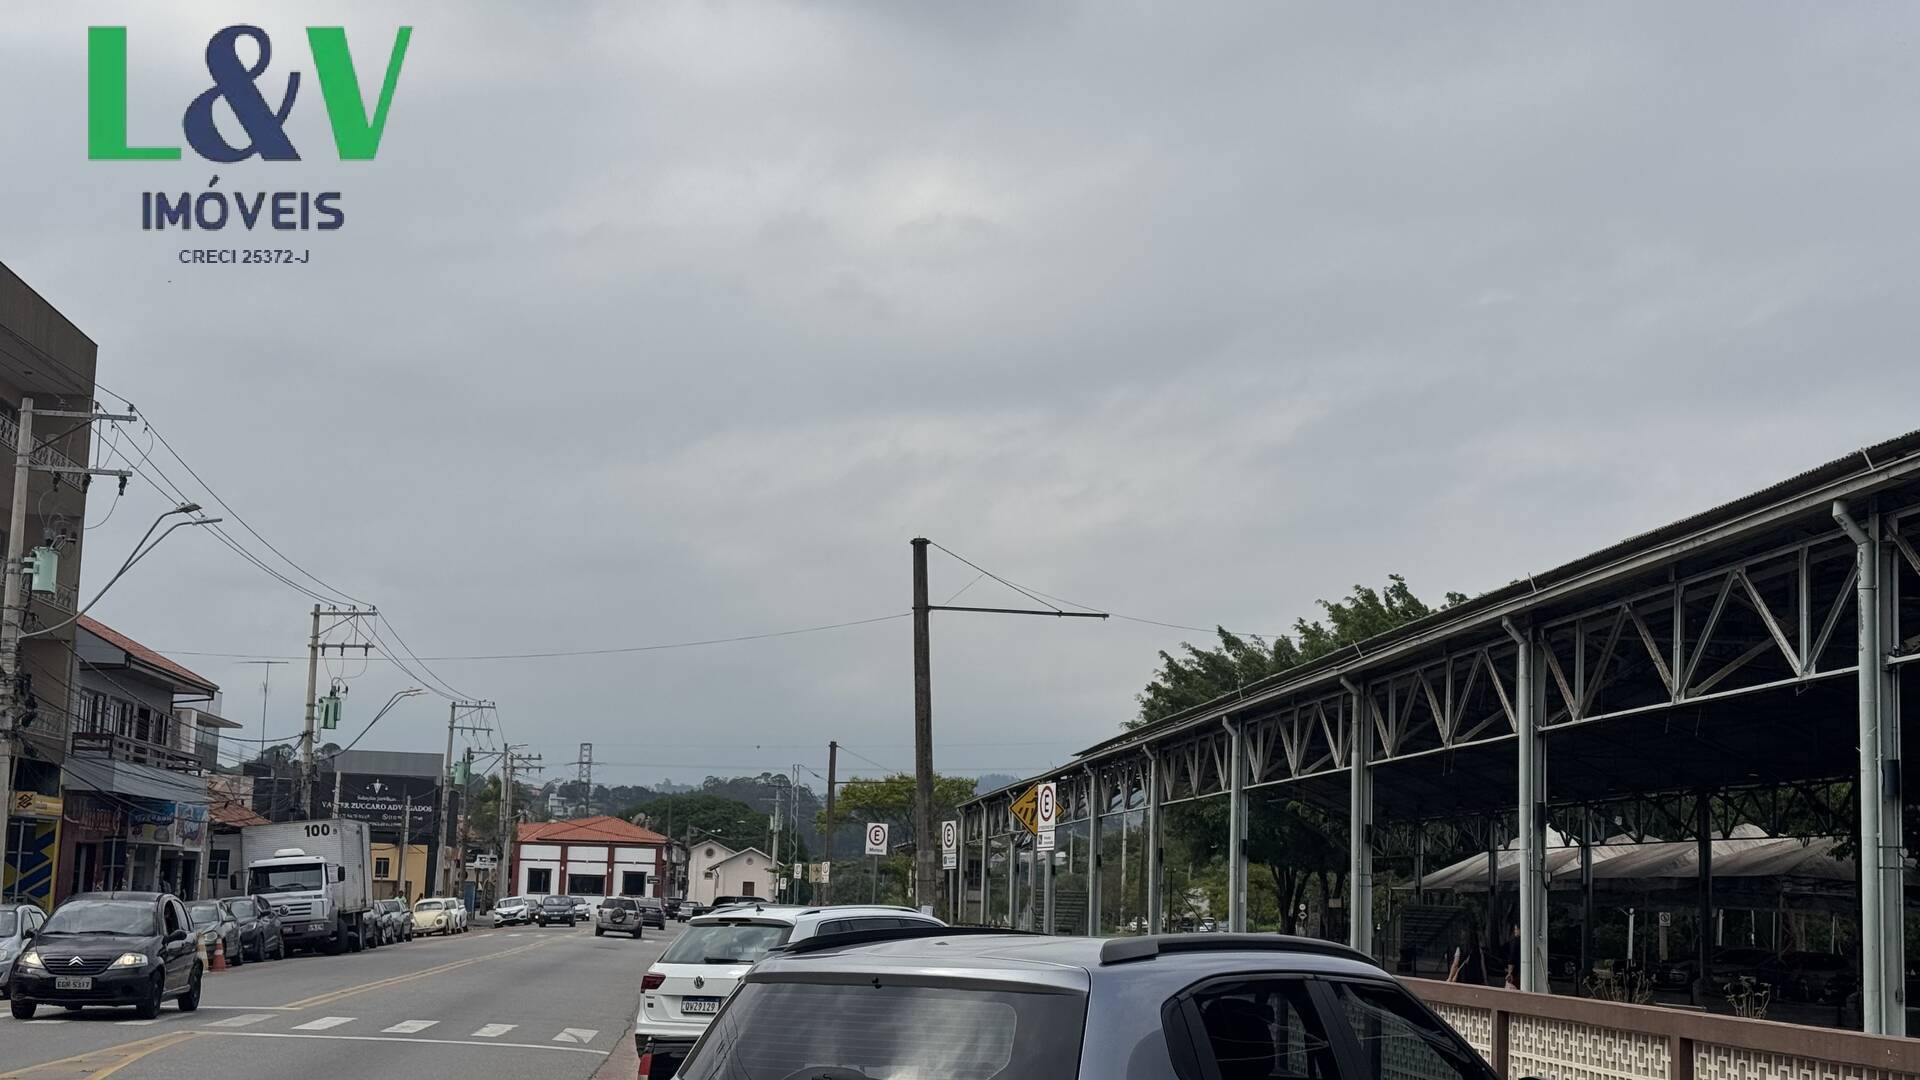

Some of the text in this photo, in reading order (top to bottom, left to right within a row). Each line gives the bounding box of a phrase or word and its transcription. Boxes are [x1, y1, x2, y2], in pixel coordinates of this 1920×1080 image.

[350, 802, 387, 811] ZUCCARO
[387, 804, 433, 813] ADVGADOS
[304, 823, 330, 838] 100
